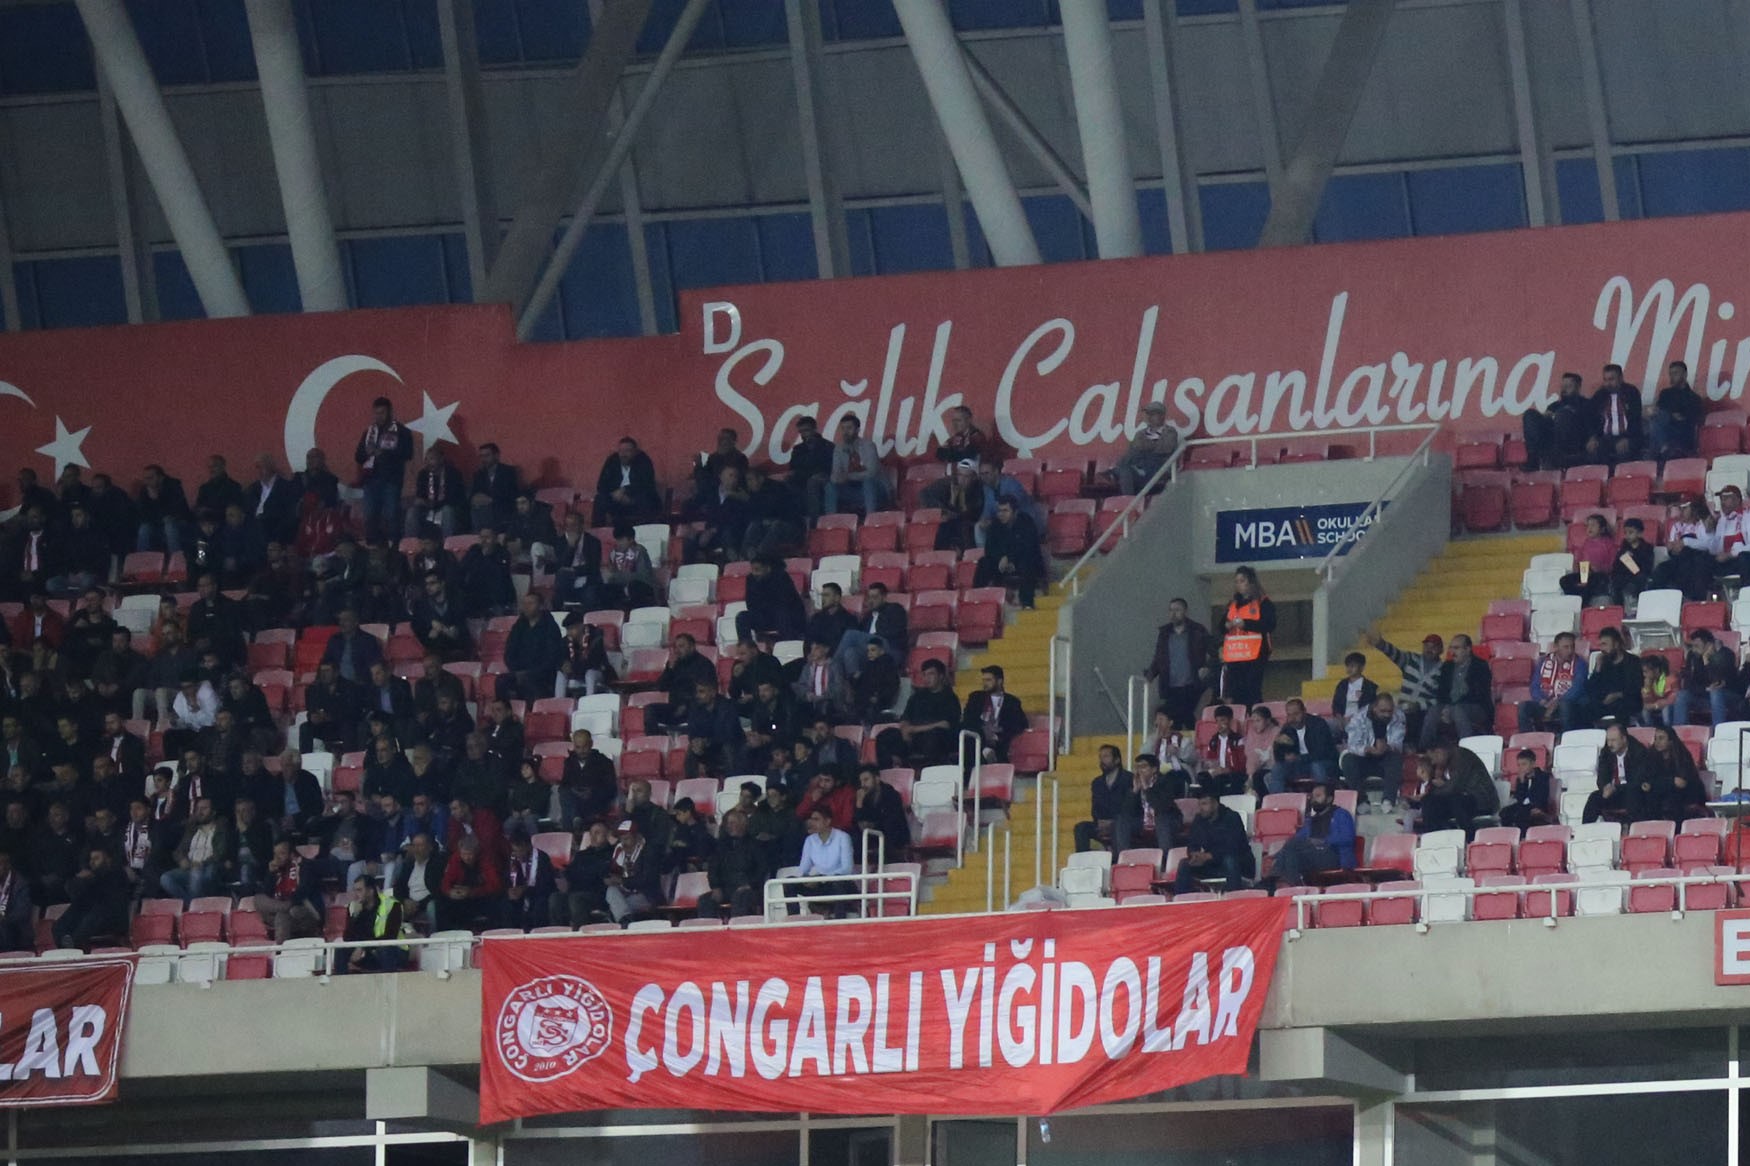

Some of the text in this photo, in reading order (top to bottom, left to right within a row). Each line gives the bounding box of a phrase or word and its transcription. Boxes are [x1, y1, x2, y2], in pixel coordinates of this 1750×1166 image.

[703, 300, 742, 355] D
[1235, 520, 1297, 549] MBA
[1317, 515, 1377, 530] OKULLA
[624, 937, 1255, 1083] ÇONGARLI YİĞİDOLAR
